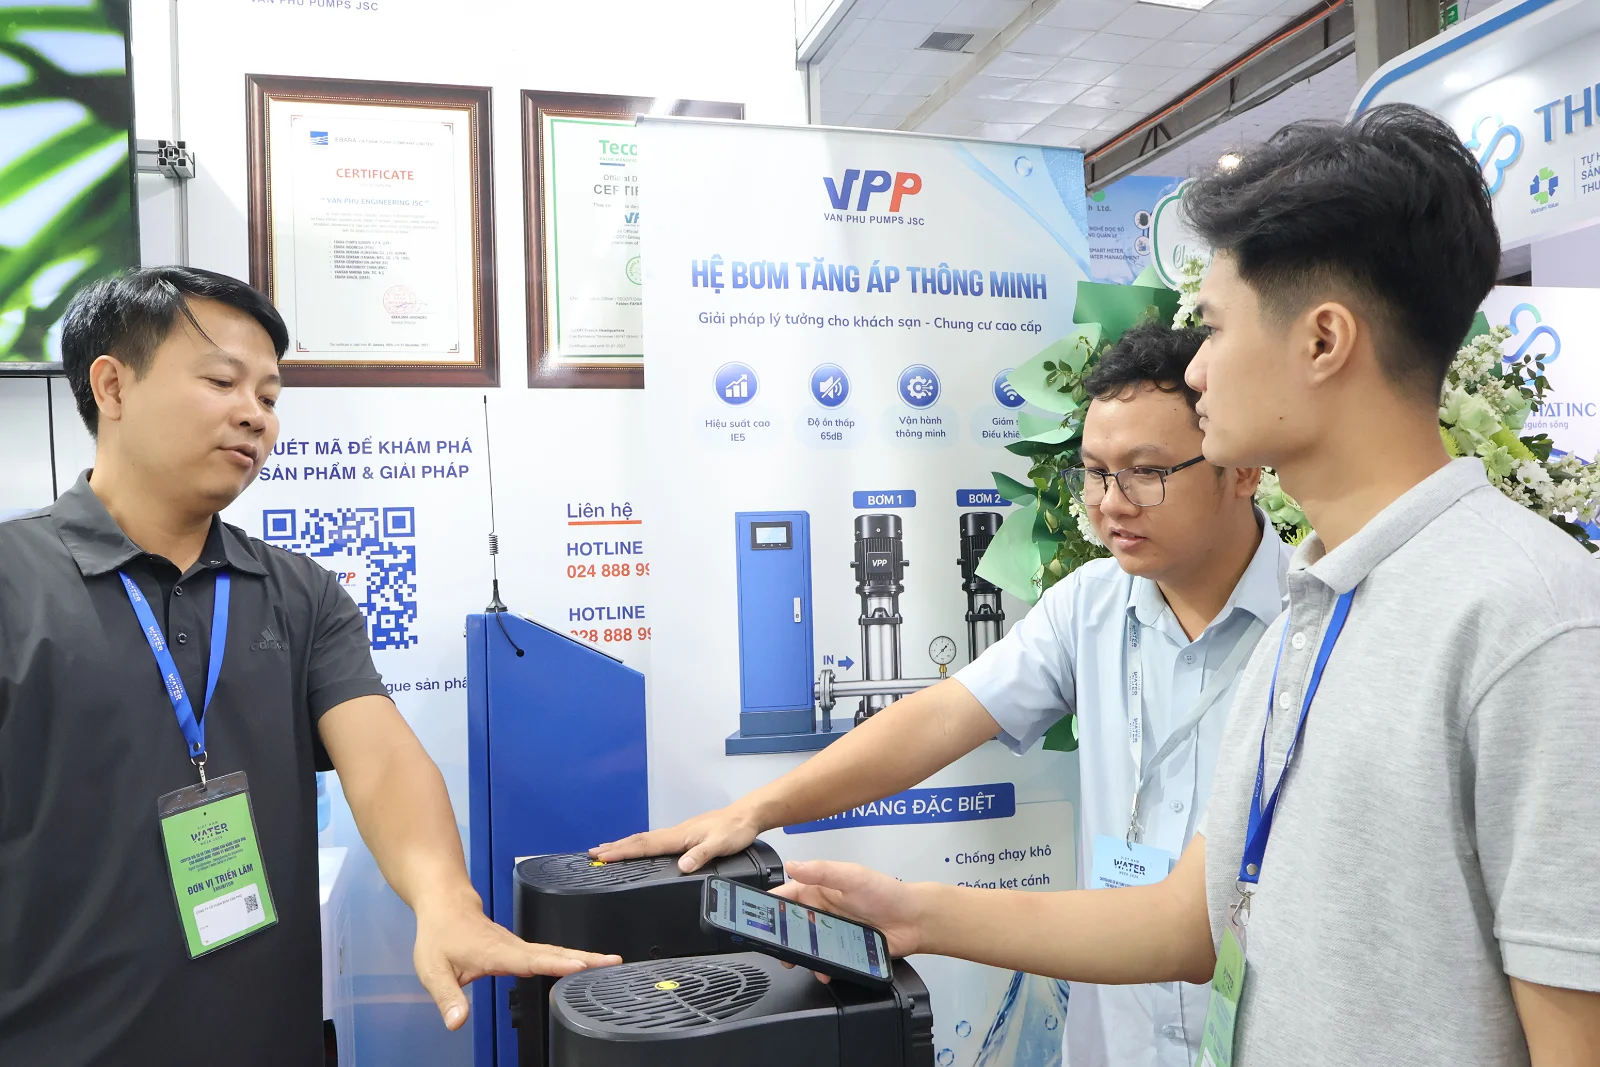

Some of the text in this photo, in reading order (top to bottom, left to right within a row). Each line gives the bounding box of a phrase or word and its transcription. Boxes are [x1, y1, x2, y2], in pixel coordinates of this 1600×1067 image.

[309, 0, 351, 9] PUMPS
[356, 1, 379, 11] JSC
[1534, 82, 1600, 143] TH
[336, 168, 415, 181] CERTIFICATE
[603, 174, 630, 182] Offical
[823, 169, 923, 213] VPP
[361, 198, 410, 206] ENGINEERING
[824, 213, 925, 226] VAN PHU PUMPS JSC
[691, 253, 1048, 300] HỆ BƠM TĂNG ÁP THÔNG MINH
[698, 311, 725, 324] Giải
[729, 312, 765, 328] pháp
[769, 312, 781, 328] lý
[785, 312, 824, 329] tưởng
[827, 314, 850, 327] cho
[853, 315, 894, 328] khách
[898, 317, 921, 330] sạn
[933, 317, 974, 333] Chung
[977, 320, 992, 331] cư
[995, 321, 1017, 332] cao
[1020, 319, 1043, 335] cấp
[1567, 402, 1597, 417] INC
[705, 418, 771, 429] Hiệu suất cao
[807, 417, 820, 428] Độ
[835, 418, 855, 429] thấp
[899, 415, 942, 426] Vận hành
[992, 417, 1014, 426] Giám
[730, 433, 746, 441] IE5
[820, 432, 843, 440] 65dB
[895, 429, 922, 439] thông
[269, 436, 473, 456] UÉT MÃ ĐỂ KHÁM PHÁ
[259, 462, 470, 481] SẢN PHẨM & GIẢI PHÁP
[867, 494, 902, 506] BƠM 1
[969, 492, 1001, 504] BƠM 2
[567, 502, 633, 520] Liên hệ
[567, 541, 644, 556] HOTLINE
[872, 558, 888, 568] VPP
[336, 572, 356, 584] PP
[567, 564, 596, 579] 024
[601, 563, 630, 577] 888
[569, 605, 646, 622] HOTLINE
[149, 626, 164, 652] WATER
[603, 627, 632, 642] 888
[823, 655, 834, 666] IN
[168, 673, 182, 701] WATER
[415, 677, 440, 691] sản
[912, 795, 953, 817] ĐẶC
[958, 792, 995, 814] BIỆT
[190, 822, 229, 843] WATER
[955, 844, 1052, 864] Chống chạy khô
[1114, 859, 1146, 875] WATER
[187, 863, 254, 895] ĐƠN VỊ TRIỂN LÃM
[1000, 877, 1018, 890] kẹt
[1021, 873, 1050, 887] cánh
